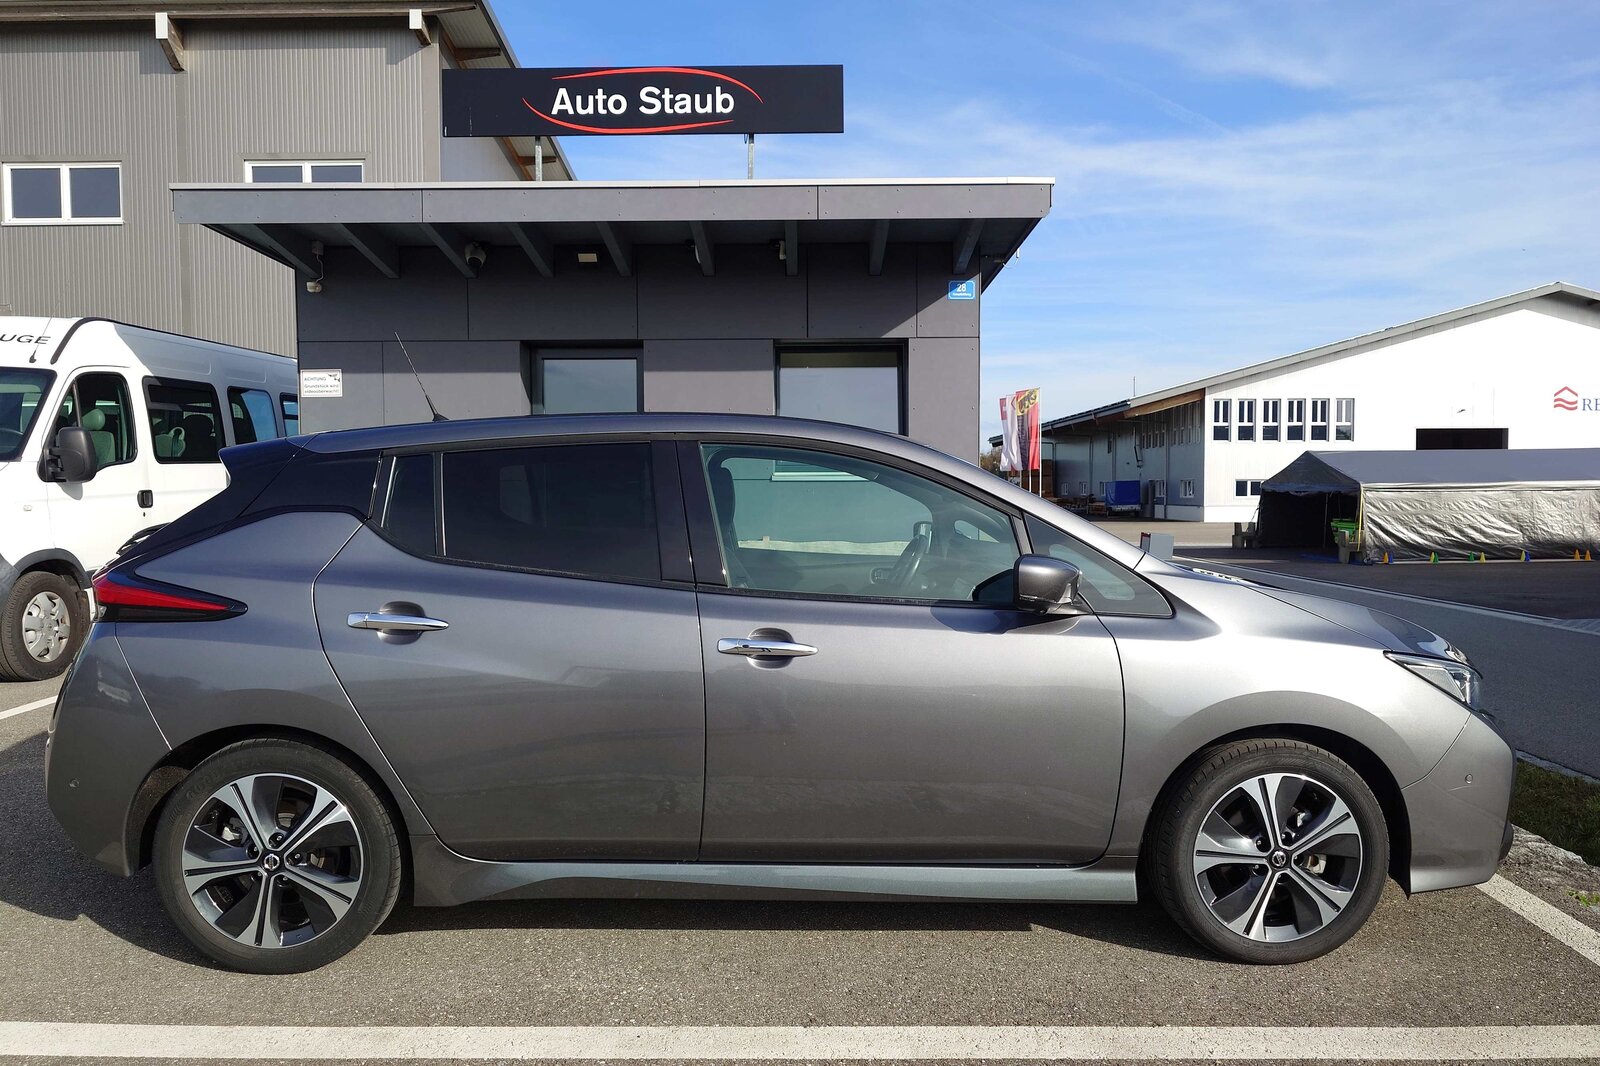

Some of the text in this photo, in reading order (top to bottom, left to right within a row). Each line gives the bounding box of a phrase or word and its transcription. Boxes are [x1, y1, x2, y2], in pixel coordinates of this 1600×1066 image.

[550, 86, 735, 115] Auto Staub
[957, 283, 967, 292] 28
[0, 333, 51, 344] UGE
